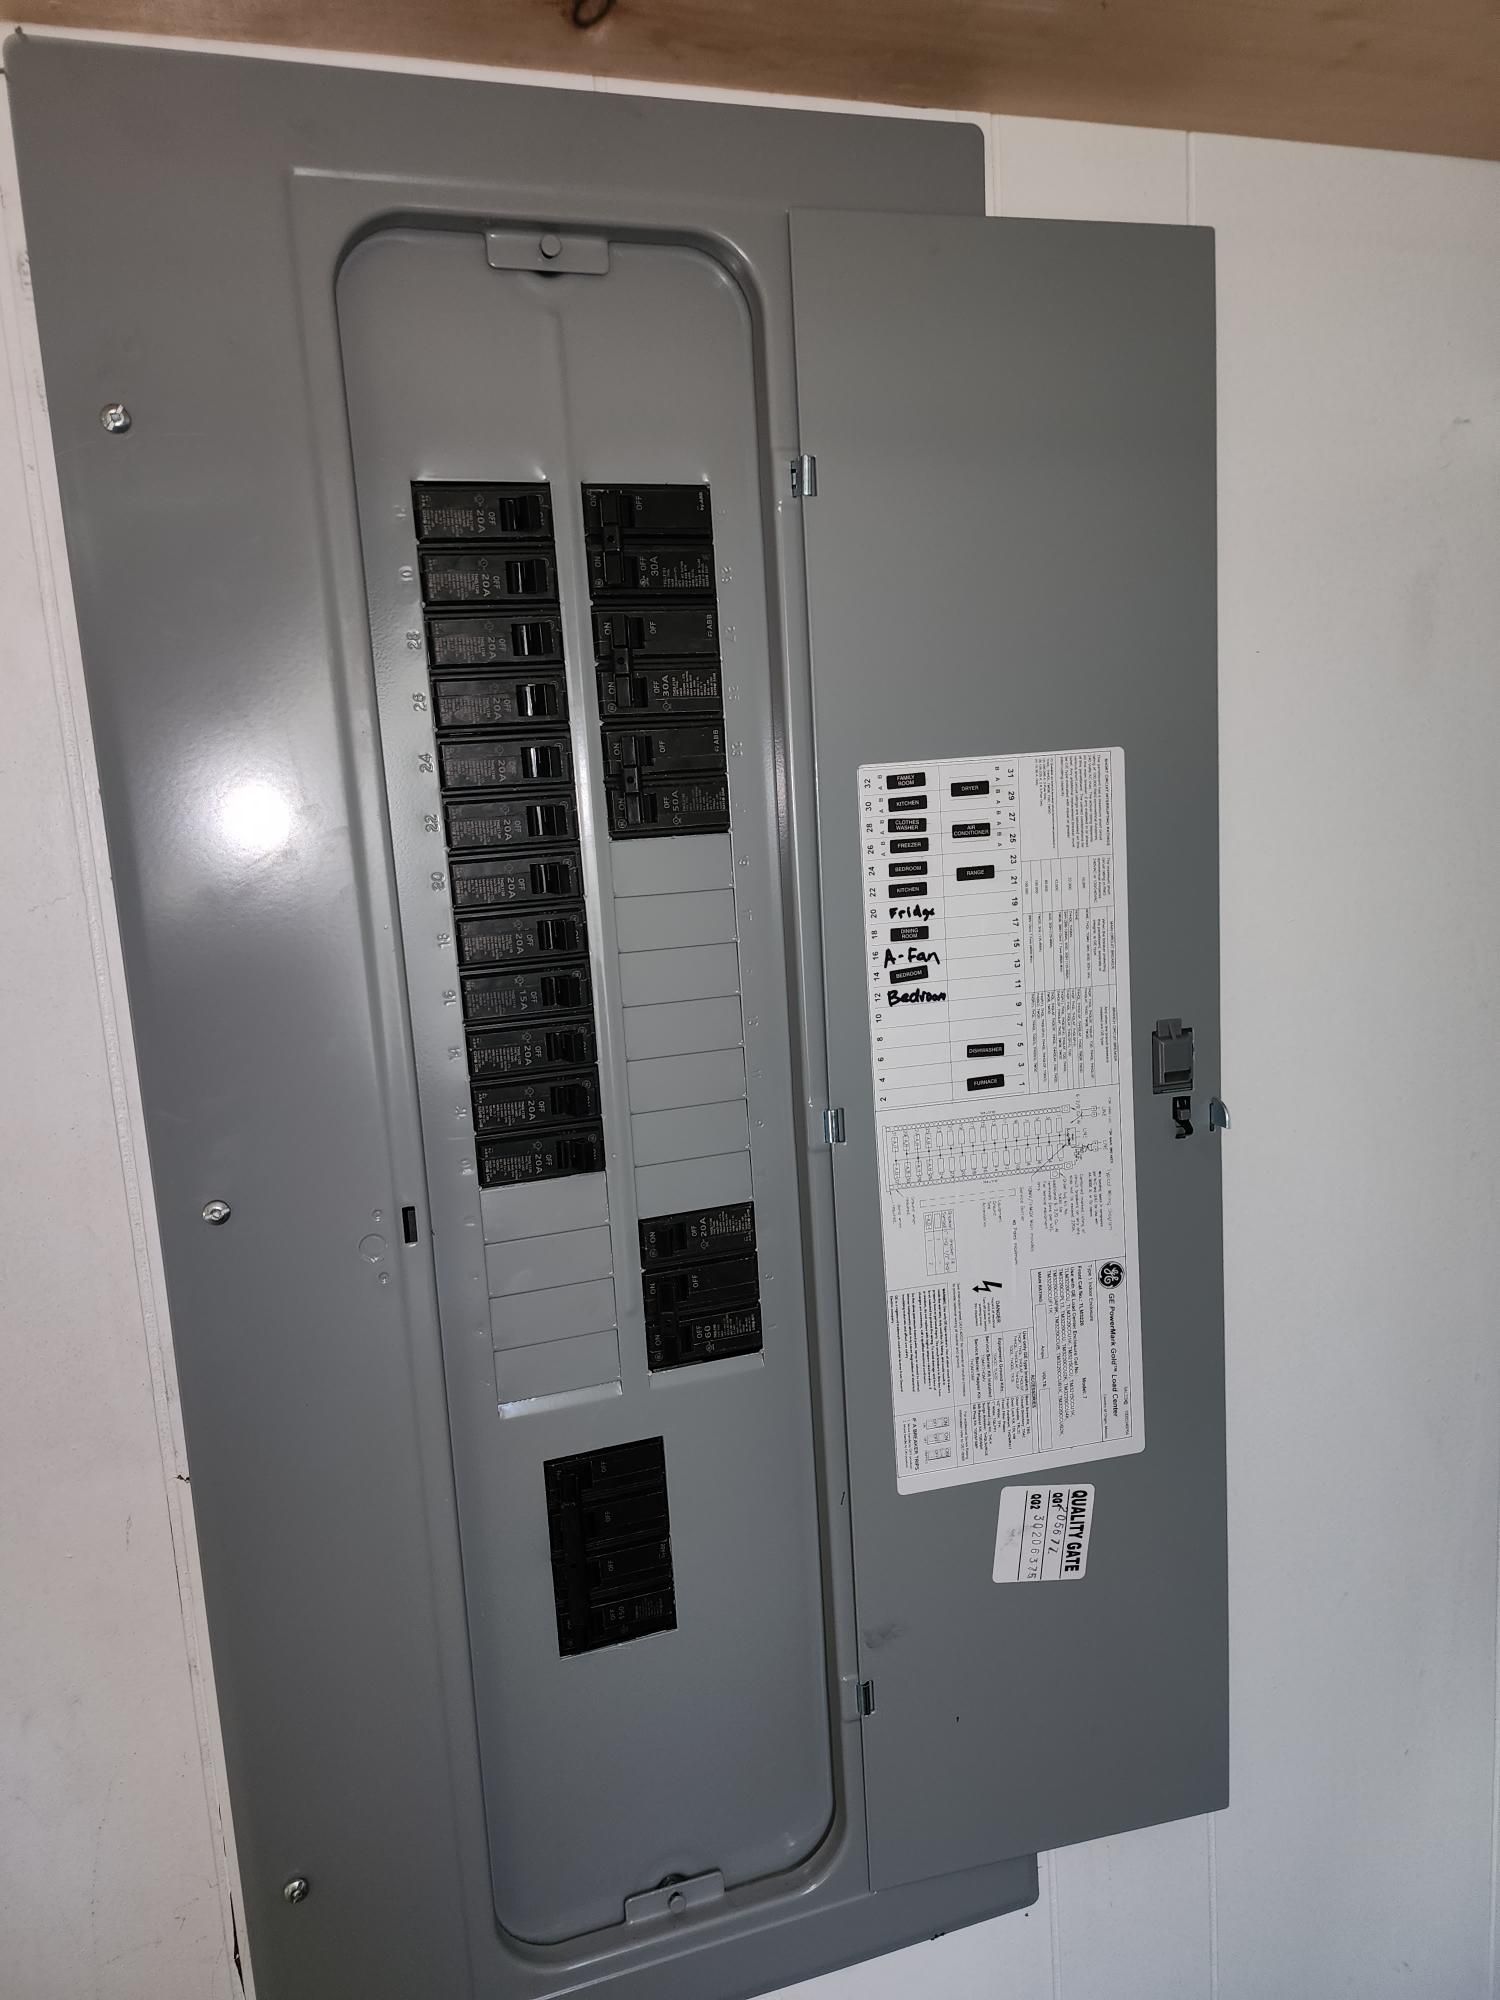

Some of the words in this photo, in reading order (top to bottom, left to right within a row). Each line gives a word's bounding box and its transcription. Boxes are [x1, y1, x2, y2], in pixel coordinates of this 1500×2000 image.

[477, 509, 485, 533] 20A
[488, 512, 496, 525] OFF
[595, 556, 601, 567] ON
[651, 556, 659, 576] 30A
[481, 574, 490, 597] 20A
[492, 576, 500, 589] OFF
[604, 622, 611, 635] ON
[488, 637, 496, 659] 20A
[498, 638, 506, 651] OFF
[608, 681, 615, 694] ON
[493, 697, 501, 720] 20A
[503, 699, 511, 712] OFF
[613, 743, 620, 755] ON
[419, 753, 433, 773] 24
[498, 759, 506, 782] 20A
[1008, 769, 1014, 778] 31
[864, 779, 870, 788] 32
[1009, 791, 1014, 800] 29
[618, 797, 625, 811] ON
[866, 802, 871, 811] 30
[425, 814, 439, 832] 22
[1009, 813, 1015, 822] 27
[503, 819, 512, 841] 20A
[514, 820, 522, 833] OFF
[867, 824, 873, 832] 28
[1009, 834, 1016, 843] 25
[868, 845, 874, 854] 26
[1010, 855, 1016, 864] 23
[869, 866, 875, 875] 24
[518, 878, 526, 891] OFF
[1011, 876, 1017, 884] 21
[507, 877, 516, 899] 20A
[870, 888, 876, 897] 22
[1011, 897, 1018, 906] 19
[871, 909, 877, 918] 20
[889, 904, 935, 921] Fridge
[1012, 918, 1019, 927] 17
[526, 934, 534, 947] OFF
[872, 930, 878, 939] 18
[515, 933, 524, 954] 20A
[1014, 939, 1019, 948] 15
[873, 951, 879, 960] 16
[1014, 959, 1020, 968] 13
[874, 972, 880, 981] 14
[896, 970, 922, 978] BEDROOM
[1015, 980, 1021, 988] 11
[519, 990, 528, 1010] 15A
[875, 993, 881, 1001] 12
[876, 1014, 882, 1022] 10
[523, 1045, 532, 1066] 20A
[534, 1046, 542, 1058] OFF
[527, 1100, 536, 1121] 20A
[535, 1153, 543, 1174] 20A
[650, 1232, 656, 1243] ON
[1108, 1293, 1115, 1304] GE
[1109, 1306, 1117, 1345] PowerMark
[705, 1326, 711, 1338] 60
[655, 1334, 661, 1345] ON
[1030, 1494, 1042, 1510] QG2
[1052, 1493, 1063, 1508] QG1
[1069, 1490, 1087, 1538] QUALITY
[1065, 1542, 1082, 1572] GATE
